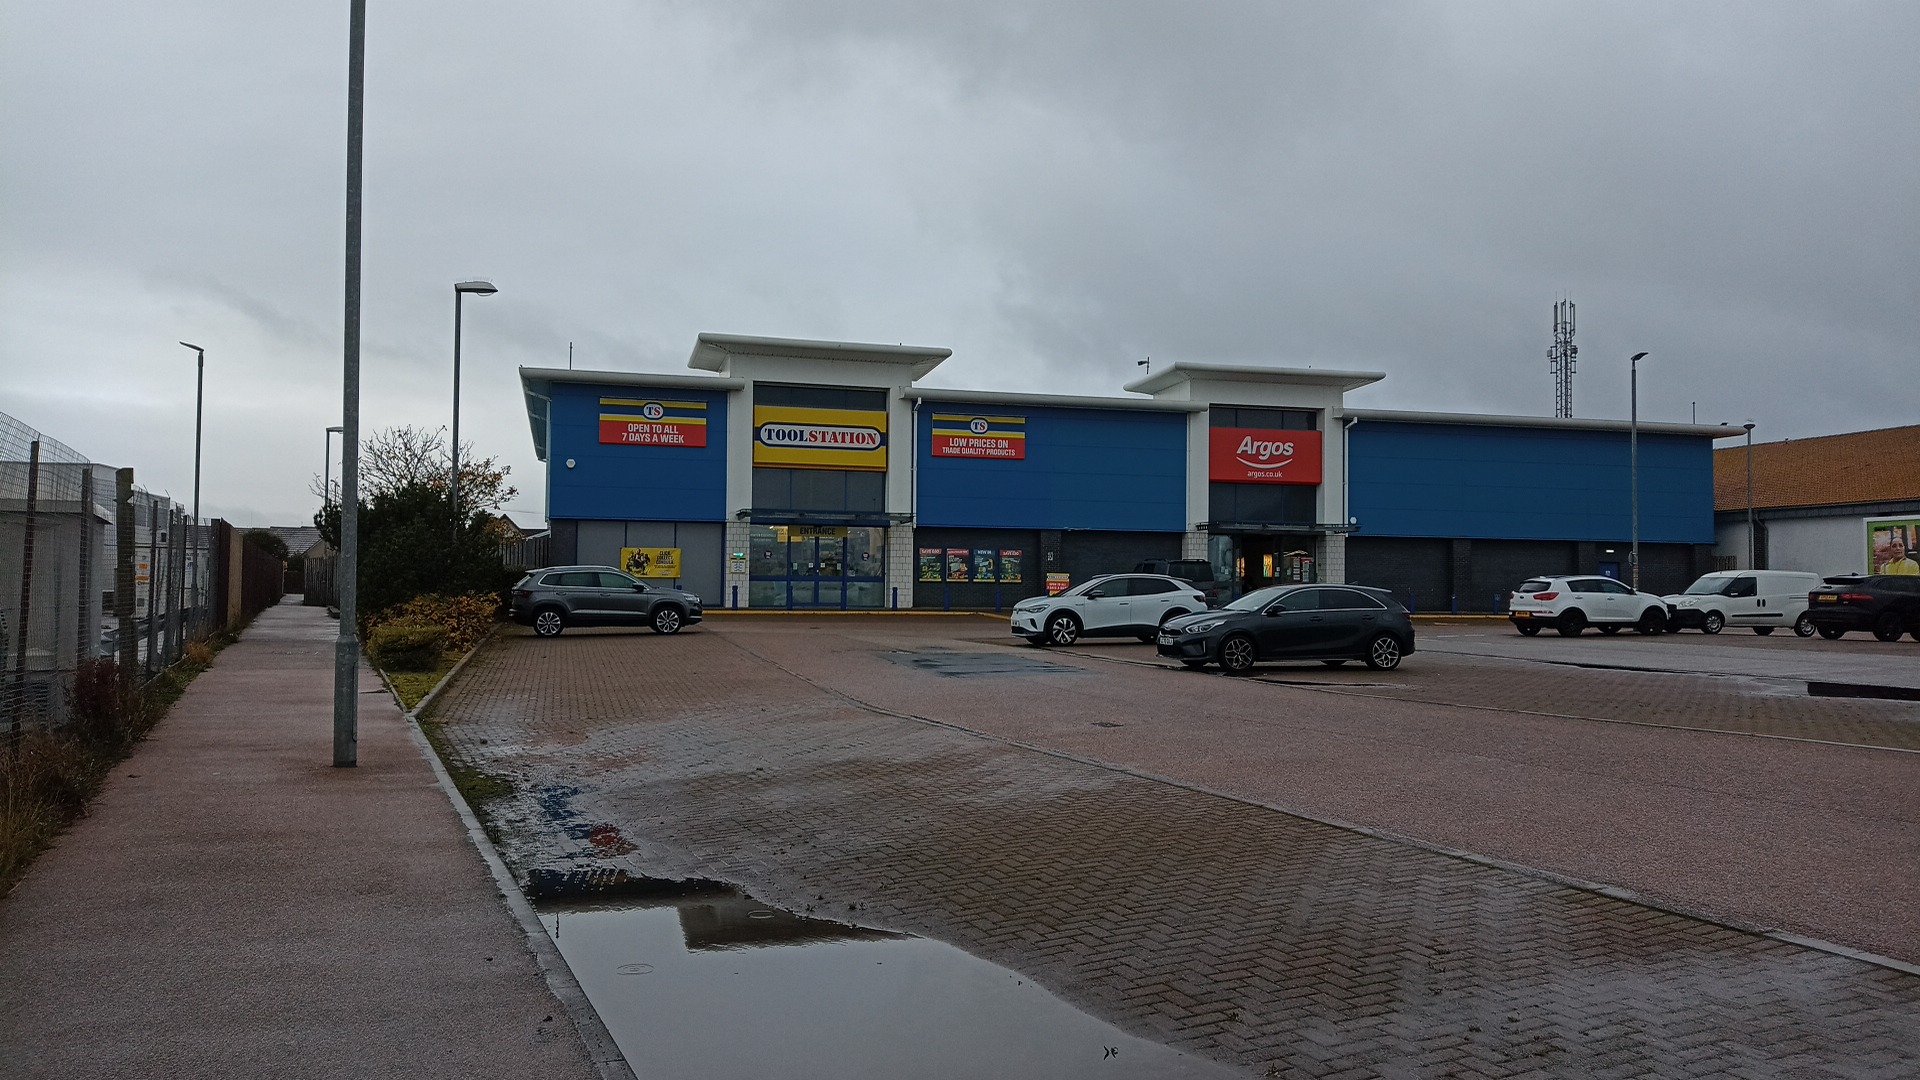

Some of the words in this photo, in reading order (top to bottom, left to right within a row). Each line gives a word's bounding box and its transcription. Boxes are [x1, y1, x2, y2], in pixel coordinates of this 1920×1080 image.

[646, 406, 661, 416] TS
[627, 423, 650, 433] OPEN
[652, 424, 662, 433] TO
[663, 425, 679, 434] ALL
[972, 421, 986, 430] TS
[622, 432, 627, 442] 7
[629, 433, 651, 443] DAYS
[652, 433, 659, 443] A
[660, 434, 685, 444] WEEK
[764, 428, 877, 445] TOOLSTATION
[949, 437, 967, 447] LOW
[969, 438, 996, 448] PRICES
[998, 439, 1009, 449] ON
[1236, 435, 1294, 461] Argos
[942, 446, 960, 454] TRADE
[961, 447, 986, 455] QUALITY
[986, 448, 1016, 456] PRODUCTS
[1247, 470, 1283, 479] argos.co.uk
[799, 526, 836, 536] ENTRANCE
